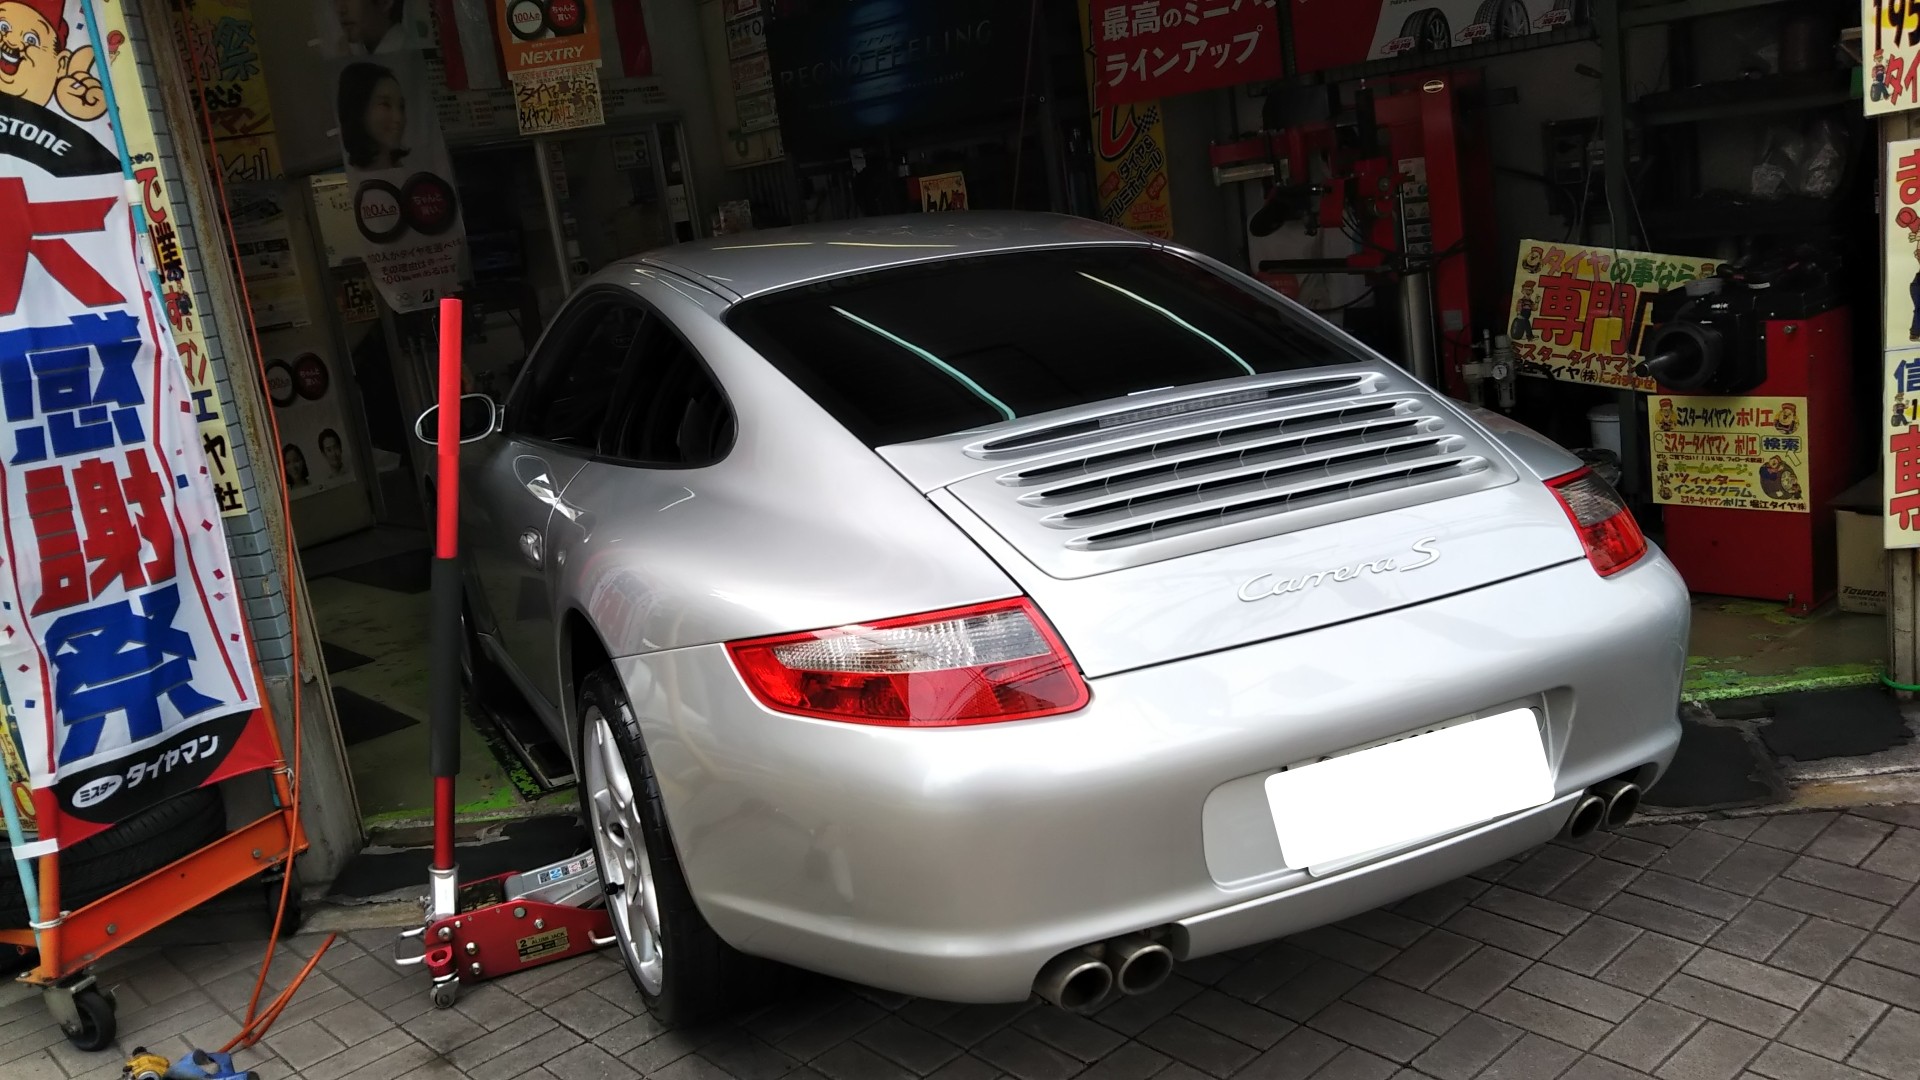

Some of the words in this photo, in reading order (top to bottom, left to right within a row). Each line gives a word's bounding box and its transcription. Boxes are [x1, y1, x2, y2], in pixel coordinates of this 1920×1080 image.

[520, 45, 585, 66] NEXTRY
[1106, 24, 1263, 87] ラインアップ
[1544, 246, 1696, 288] タイヤの事なら
[1763, 437, 1800, 451] 検索
[1238, 557, 1397, 602] Carrera
[1400, 537, 1441, 572] S
[80, 781, 116, 803] ミスター
[126, 735, 219, 789] タイヤマン
